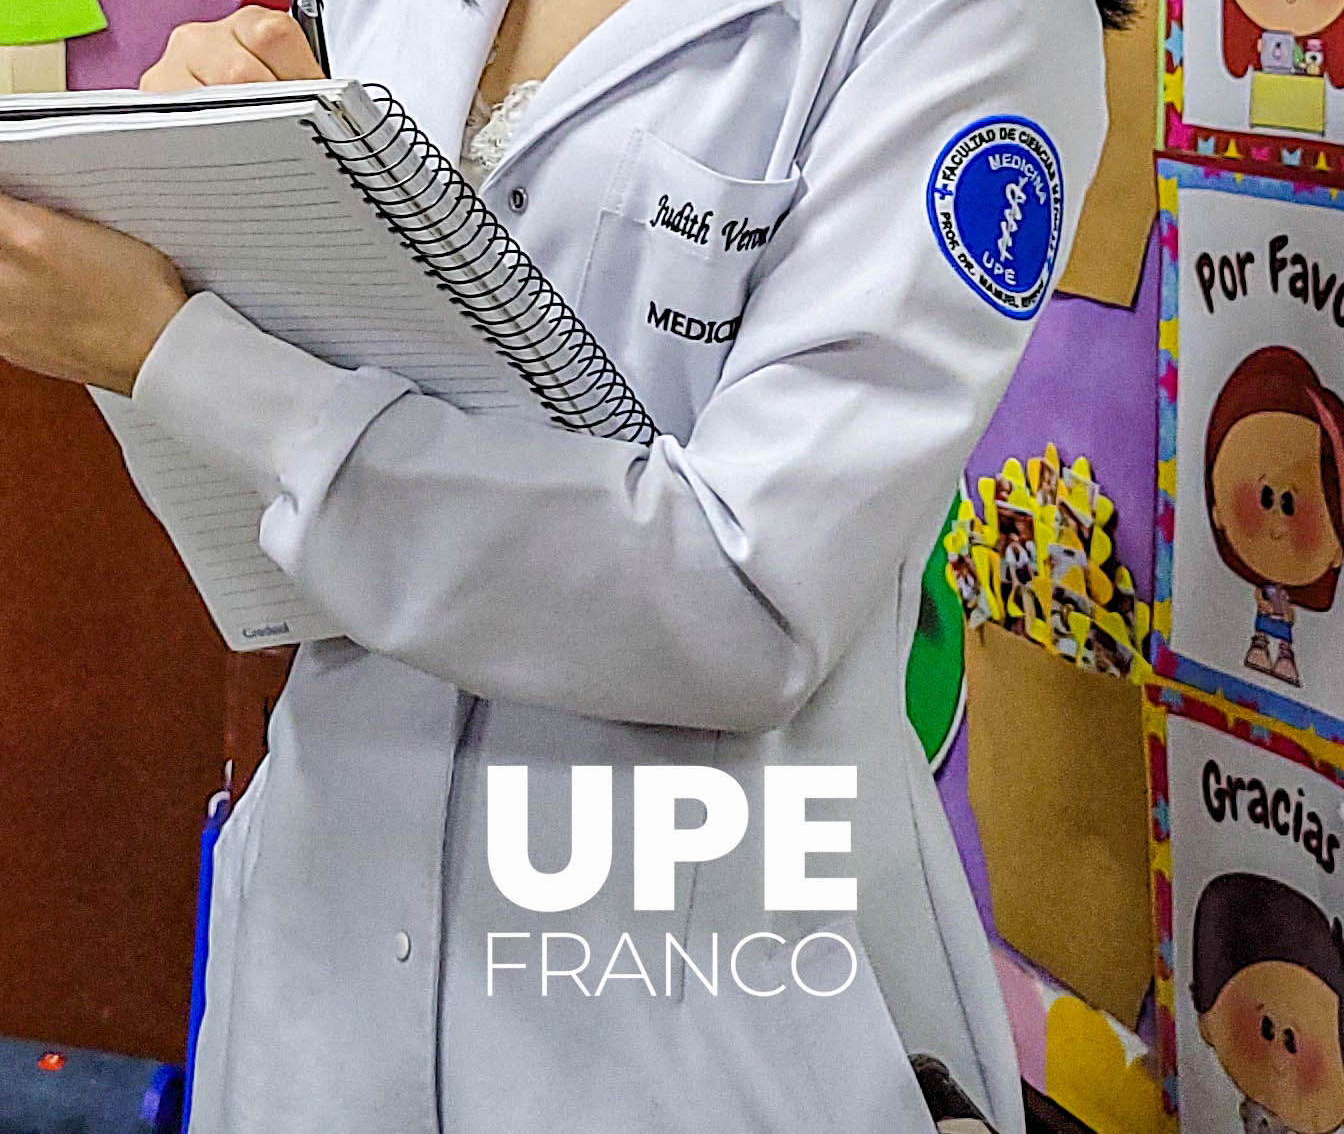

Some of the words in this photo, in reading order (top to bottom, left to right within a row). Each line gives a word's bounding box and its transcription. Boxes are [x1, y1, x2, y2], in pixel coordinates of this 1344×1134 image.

[942, 128, 997, 183] FACULTAD
[999, 127, 1017, 142] DE
[988, 152, 1047, 207] MEDICINA
[649, 193, 715, 246] Judith
[982, 251, 1017, 286] UPE
[1202, 759, 1341, 874] Gracias
